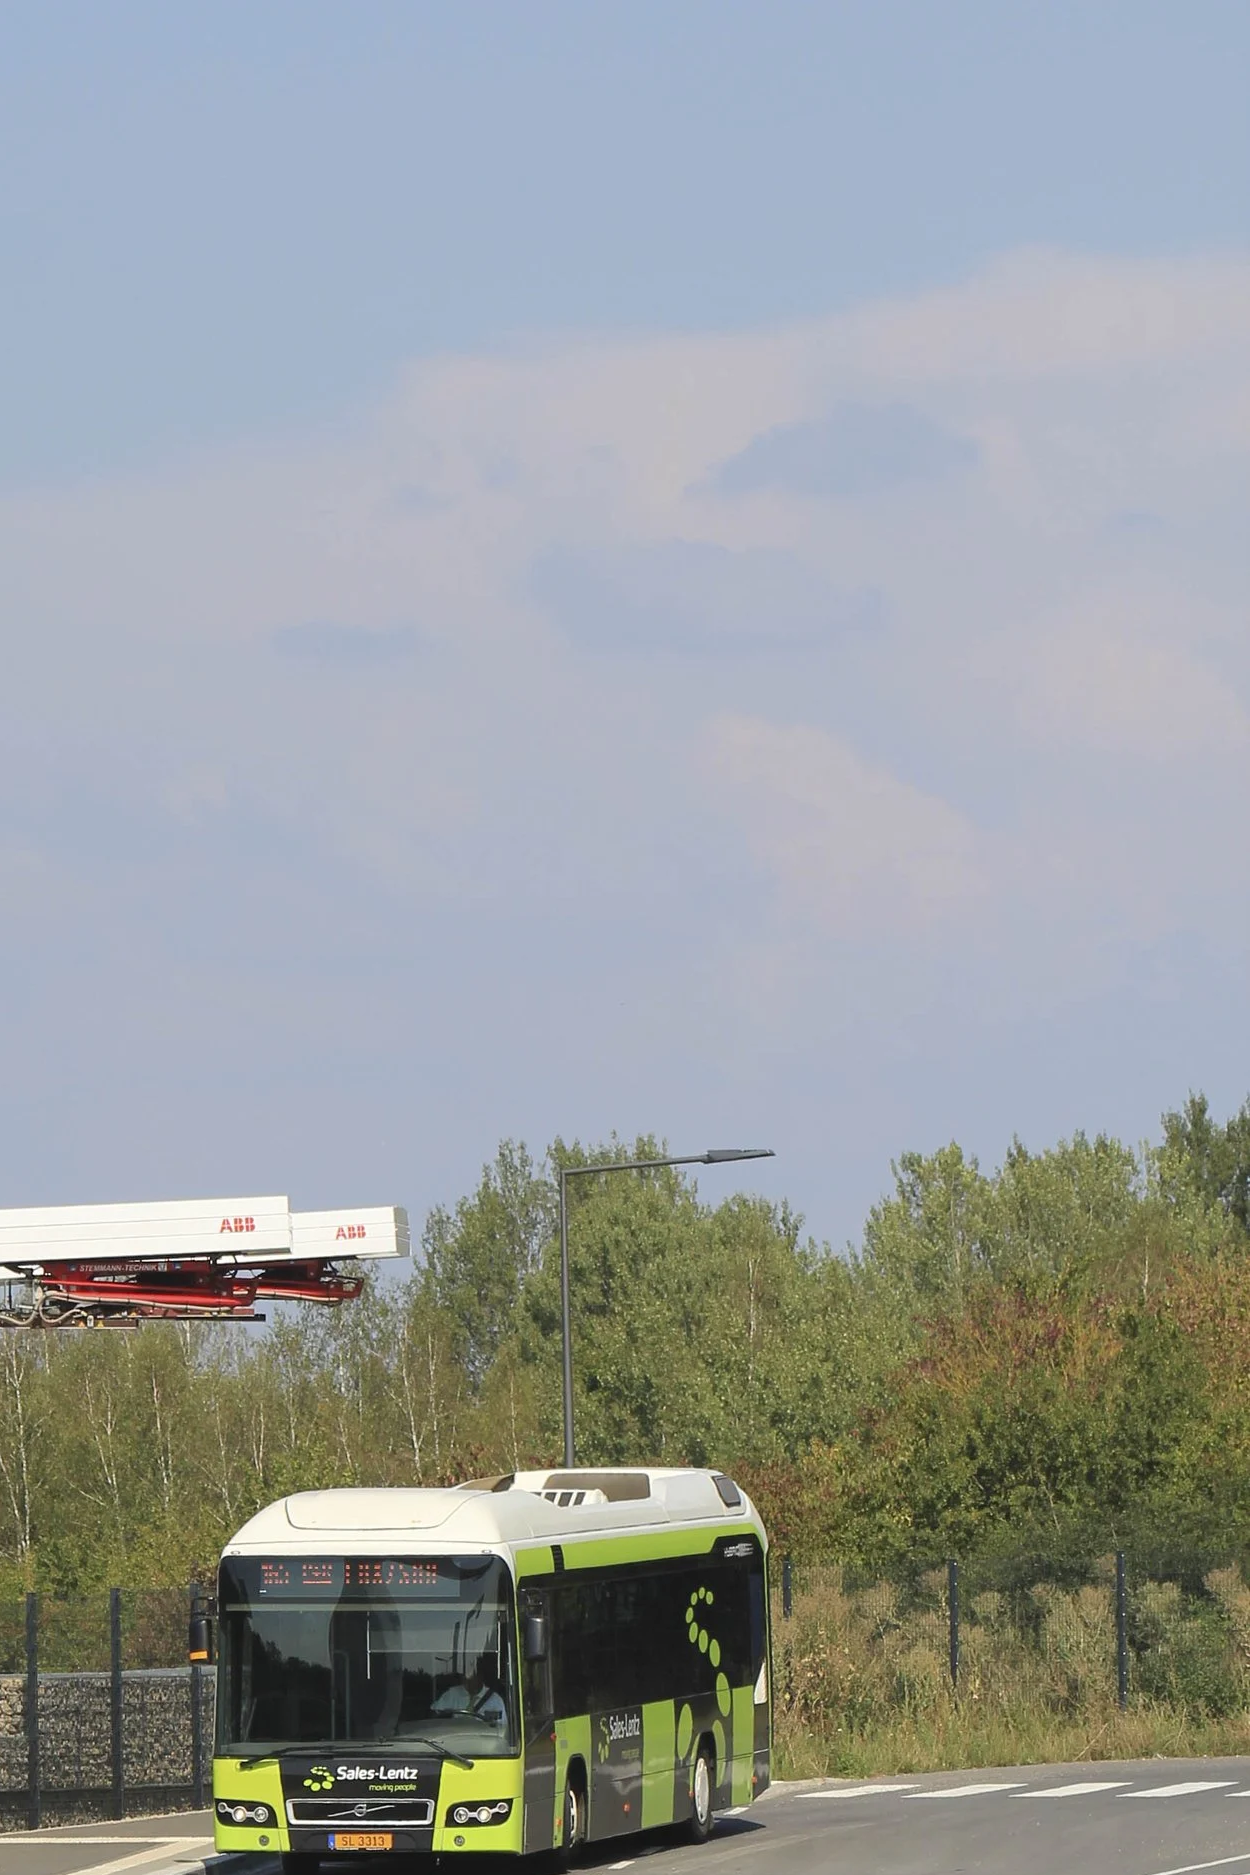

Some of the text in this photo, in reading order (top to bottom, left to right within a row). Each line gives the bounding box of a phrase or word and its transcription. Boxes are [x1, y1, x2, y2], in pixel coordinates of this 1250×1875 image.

[220, 1217, 256, 1233] ABB
[336, 1225, 366, 1240] ABB
[79, 1264, 157, 1273] STEMMANN-TECHNIK
[609, 1713, 640, 1740] Sales-Lentz
[336, 1766, 419, 1780] Sales-Lentz
[369, 1784, 417, 1793] moving people
[341, 1836, 385, 1846] SL 3313
